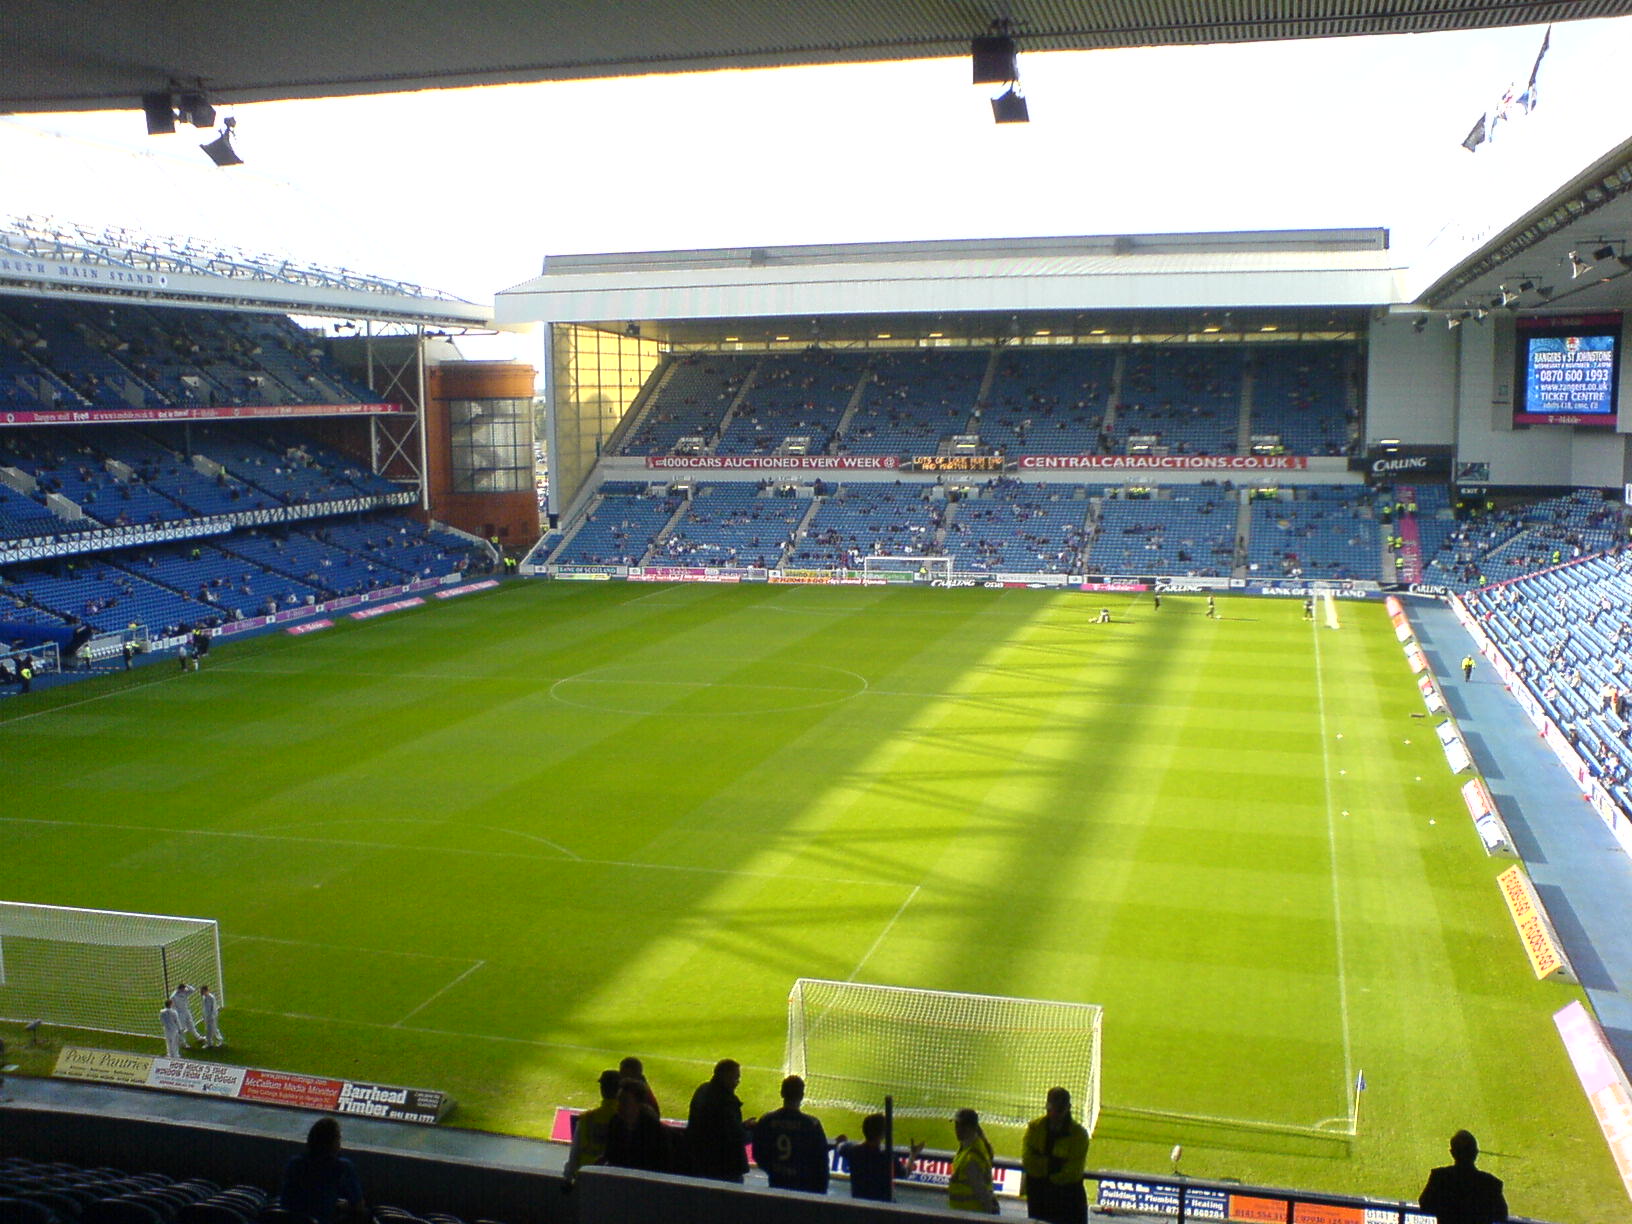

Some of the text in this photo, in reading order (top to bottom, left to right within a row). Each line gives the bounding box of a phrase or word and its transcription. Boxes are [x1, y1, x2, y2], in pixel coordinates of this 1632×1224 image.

[58, 265, 99, 279] MAIN
[109, 271, 153, 284] STAND
[1576, 351, 1613, 362] JOHNSTONE
[1540, 369, 1609, 381] 0870 600 1993
[1541, 392, 1605, 401] TICKET CENTRE
[689, 457, 722, 468] CARS
[723, 457, 799, 468] AUCTIONED
[801, 457, 840, 468] EVERY
[841, 457, 881, 468] WEEK
[1372, 456, 1428, 472] CARLING
[1261, 587, 1291, 595] BANK
[1292, 587, 1307, 596] OF
[1408, 583, 1446, 595] CARLING
[65, 1048, 150, 1070] Posh Pantries
[340, 1082, 409, 1104] Barrhead
[338, 1097, 390, 1116] Timber
[777, 1134, 792, 1160] 9
[1102, 1189, 1137, 1201] Building
[1191, 1198, 1224, 1211] Heating
